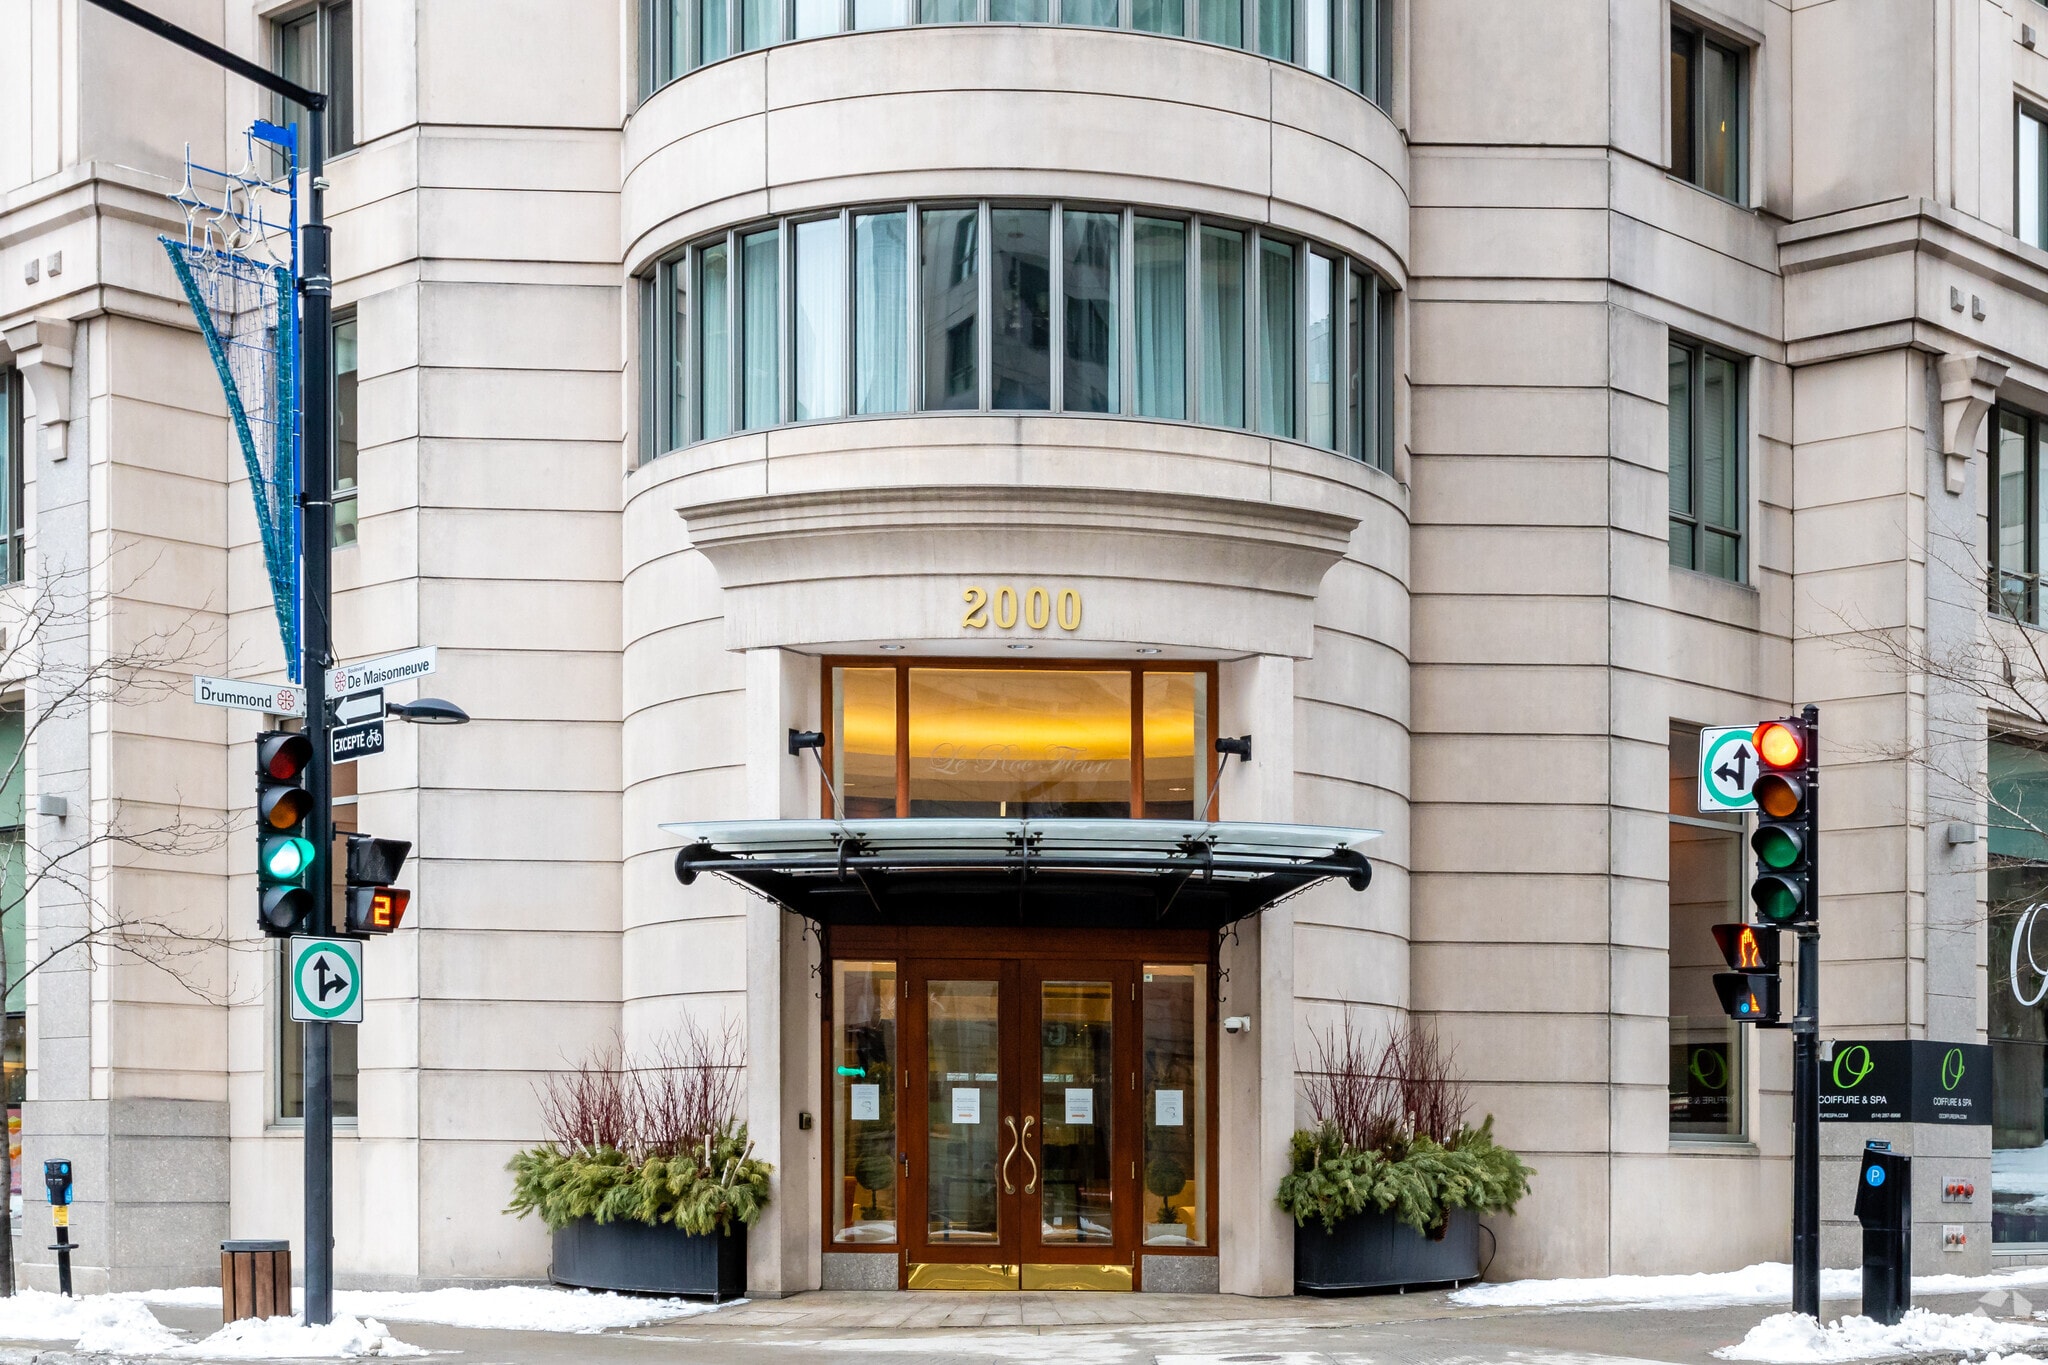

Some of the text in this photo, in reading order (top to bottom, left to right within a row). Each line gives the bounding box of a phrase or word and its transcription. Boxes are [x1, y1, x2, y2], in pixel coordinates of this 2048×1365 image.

[962, 586, 1082, 631] 2000
[347, 660, 430, 689] De Maisonneuve
[201, 686, 272, 708] Drummond
[334, 730, 366, 752] EXCEPTÉ
[929, 742, 967, 775] Le
[1039, 744, 1114, 774] Fleuri
[374, 896, 391, 926] 2
[1818, 1095, 1888, 1104] COIFFURE & SPA
[1933, 1097, 1957, 1106] COIFFURE
[1962, 1098, 1972, 1107] SPA
[1871, 1169, 1880, 1183] P
